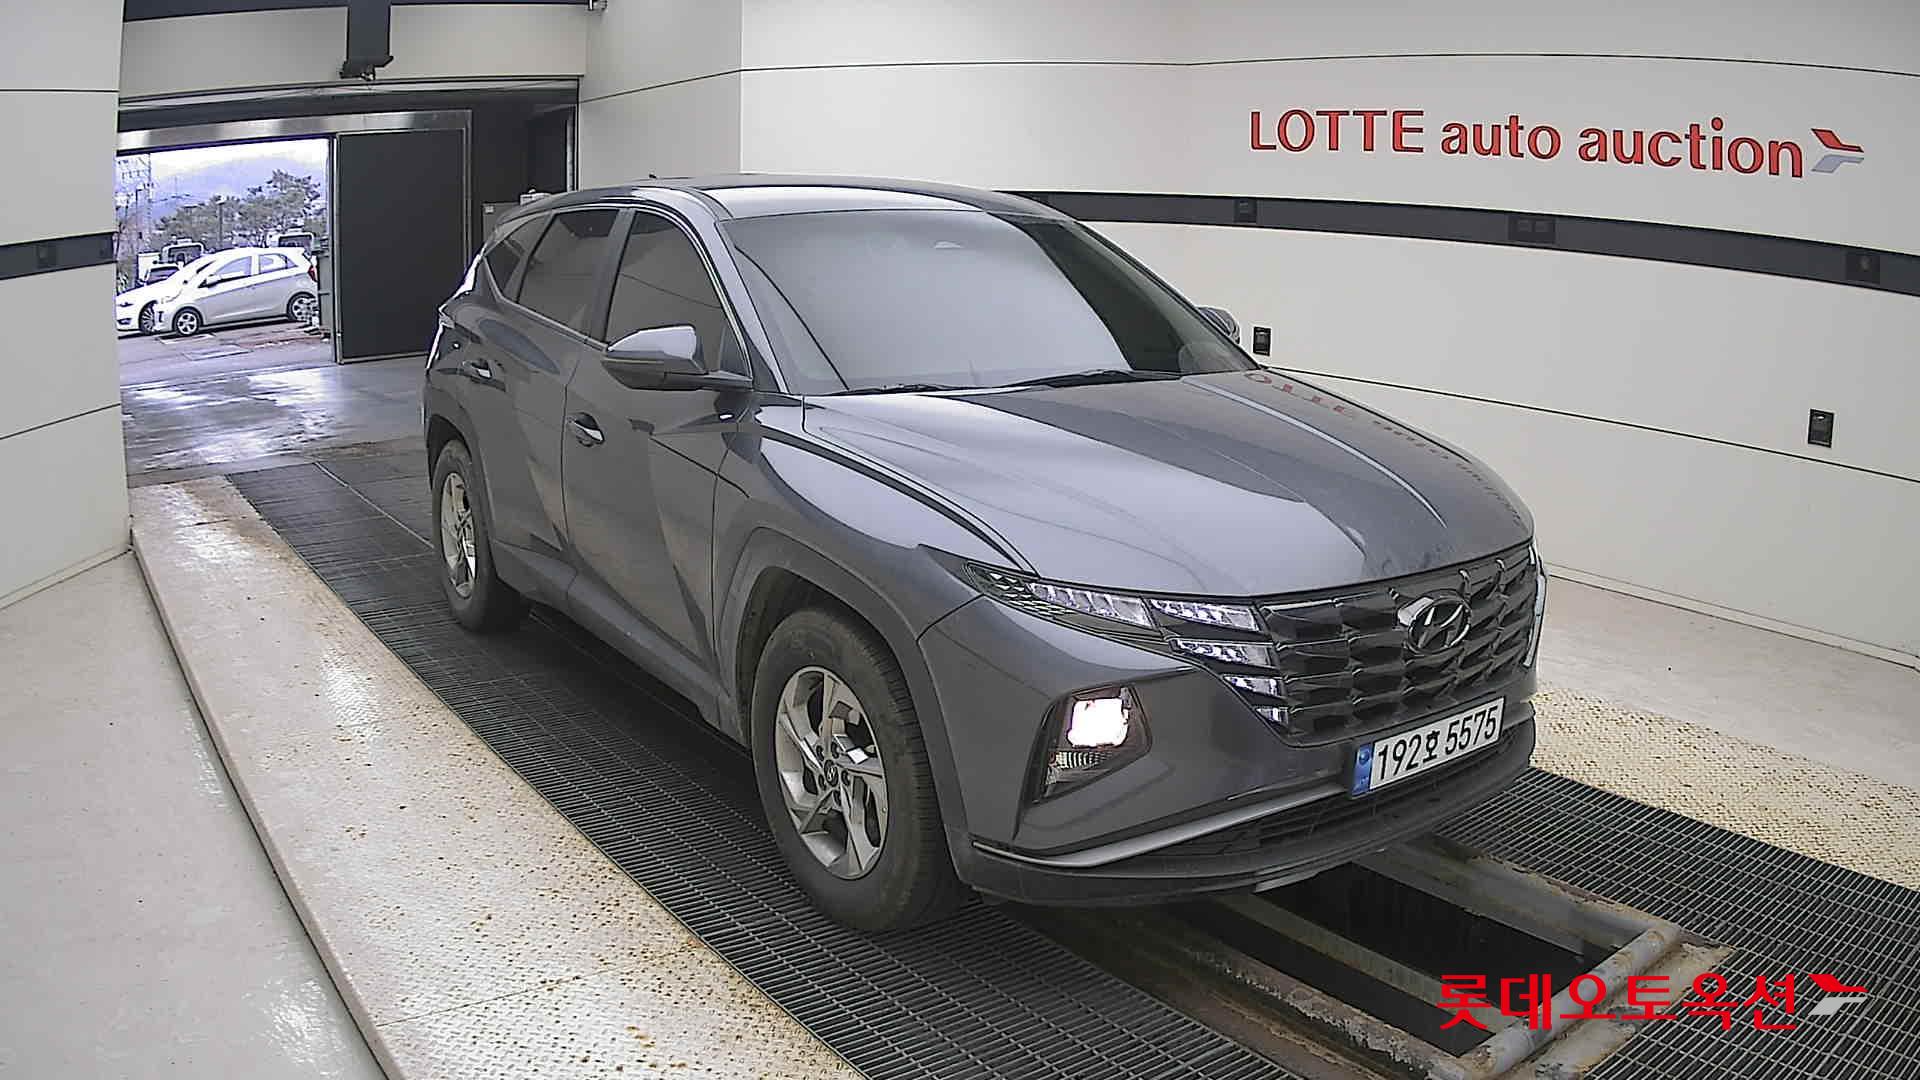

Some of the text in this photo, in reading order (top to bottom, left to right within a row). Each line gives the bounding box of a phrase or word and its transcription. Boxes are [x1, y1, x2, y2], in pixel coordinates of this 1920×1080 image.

[1250, 110, 1804, 178] LOTTE auto auction
[1378, 705, 1499, 780] 192호 5575
